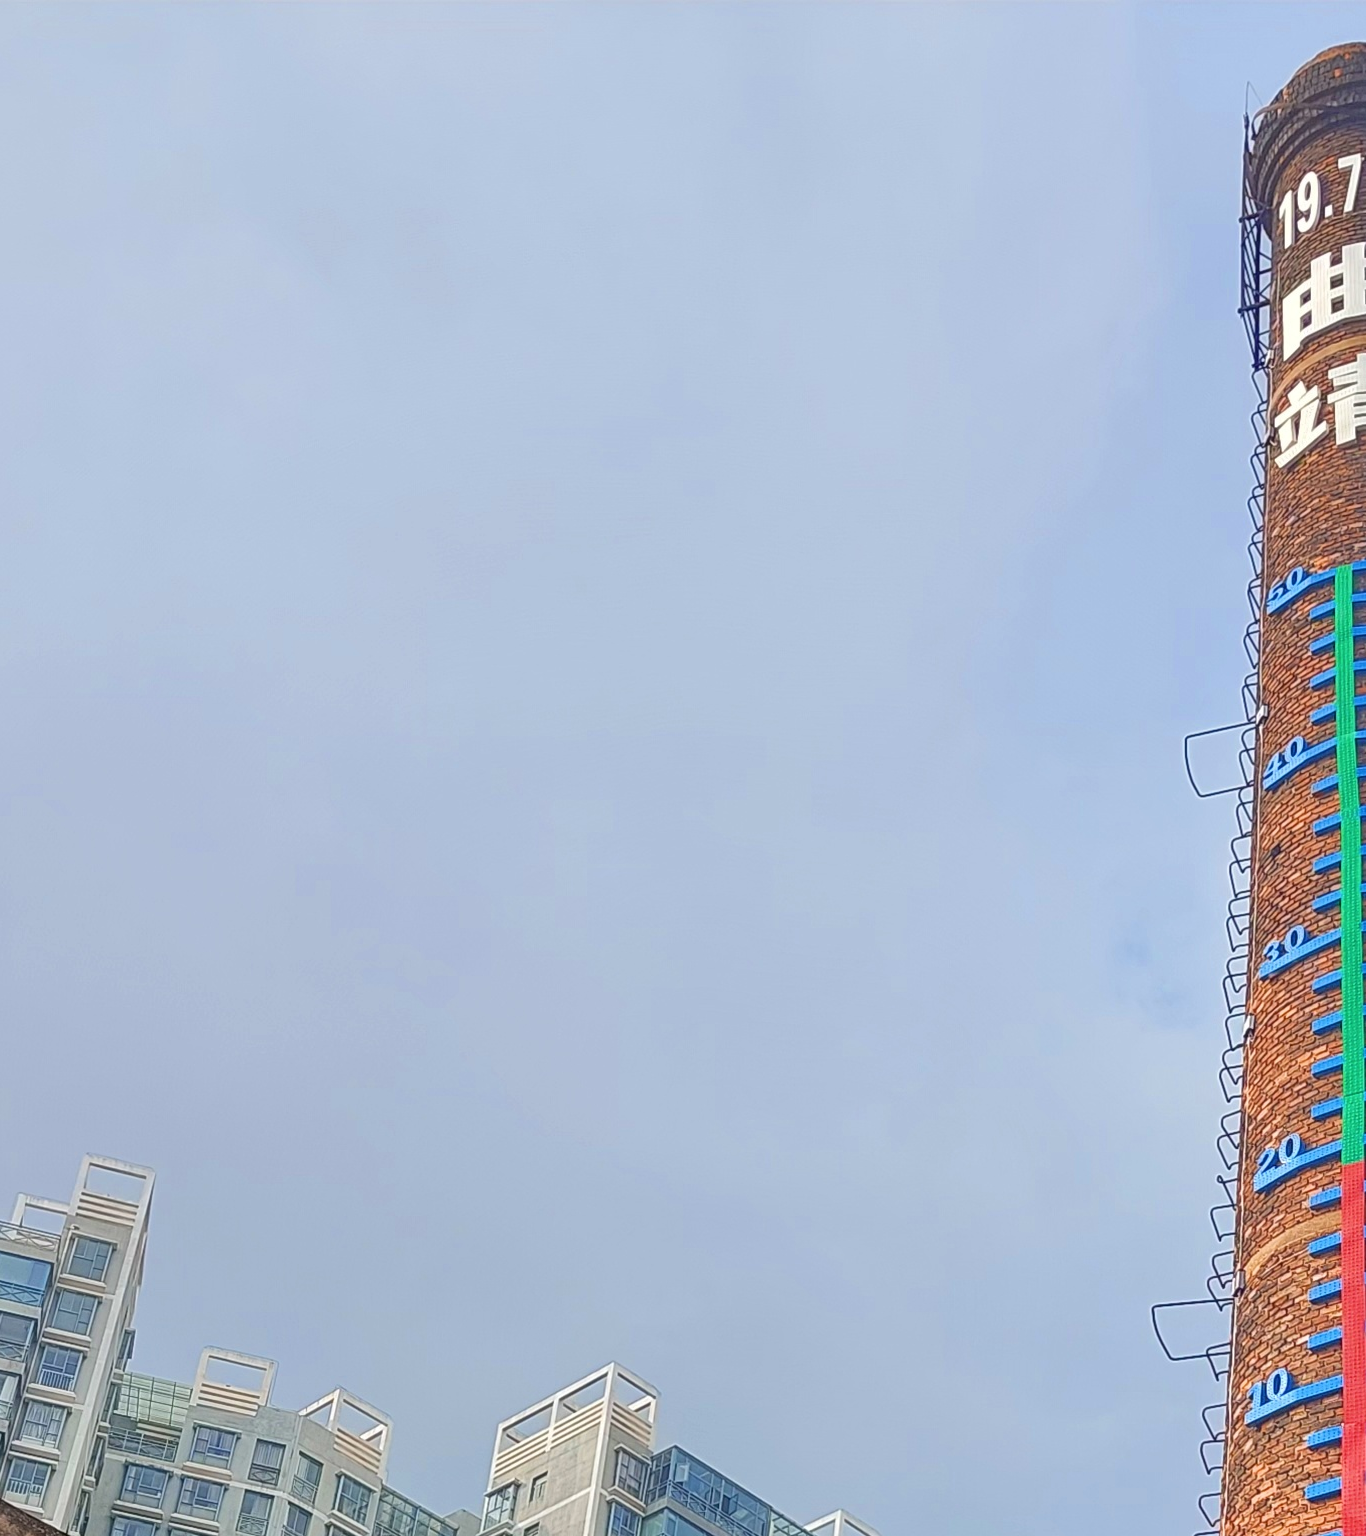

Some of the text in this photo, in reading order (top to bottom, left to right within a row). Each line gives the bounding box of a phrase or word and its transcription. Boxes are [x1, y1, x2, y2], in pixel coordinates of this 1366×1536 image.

[1267, 566, 1306, 606] 50
[1264, 736, 1308, 778] 40
[1263, 925, 1308, 962] 30
[1256, 1134, 1302, 1176] 20
[1247, 1368, 1293, 1412] 10
